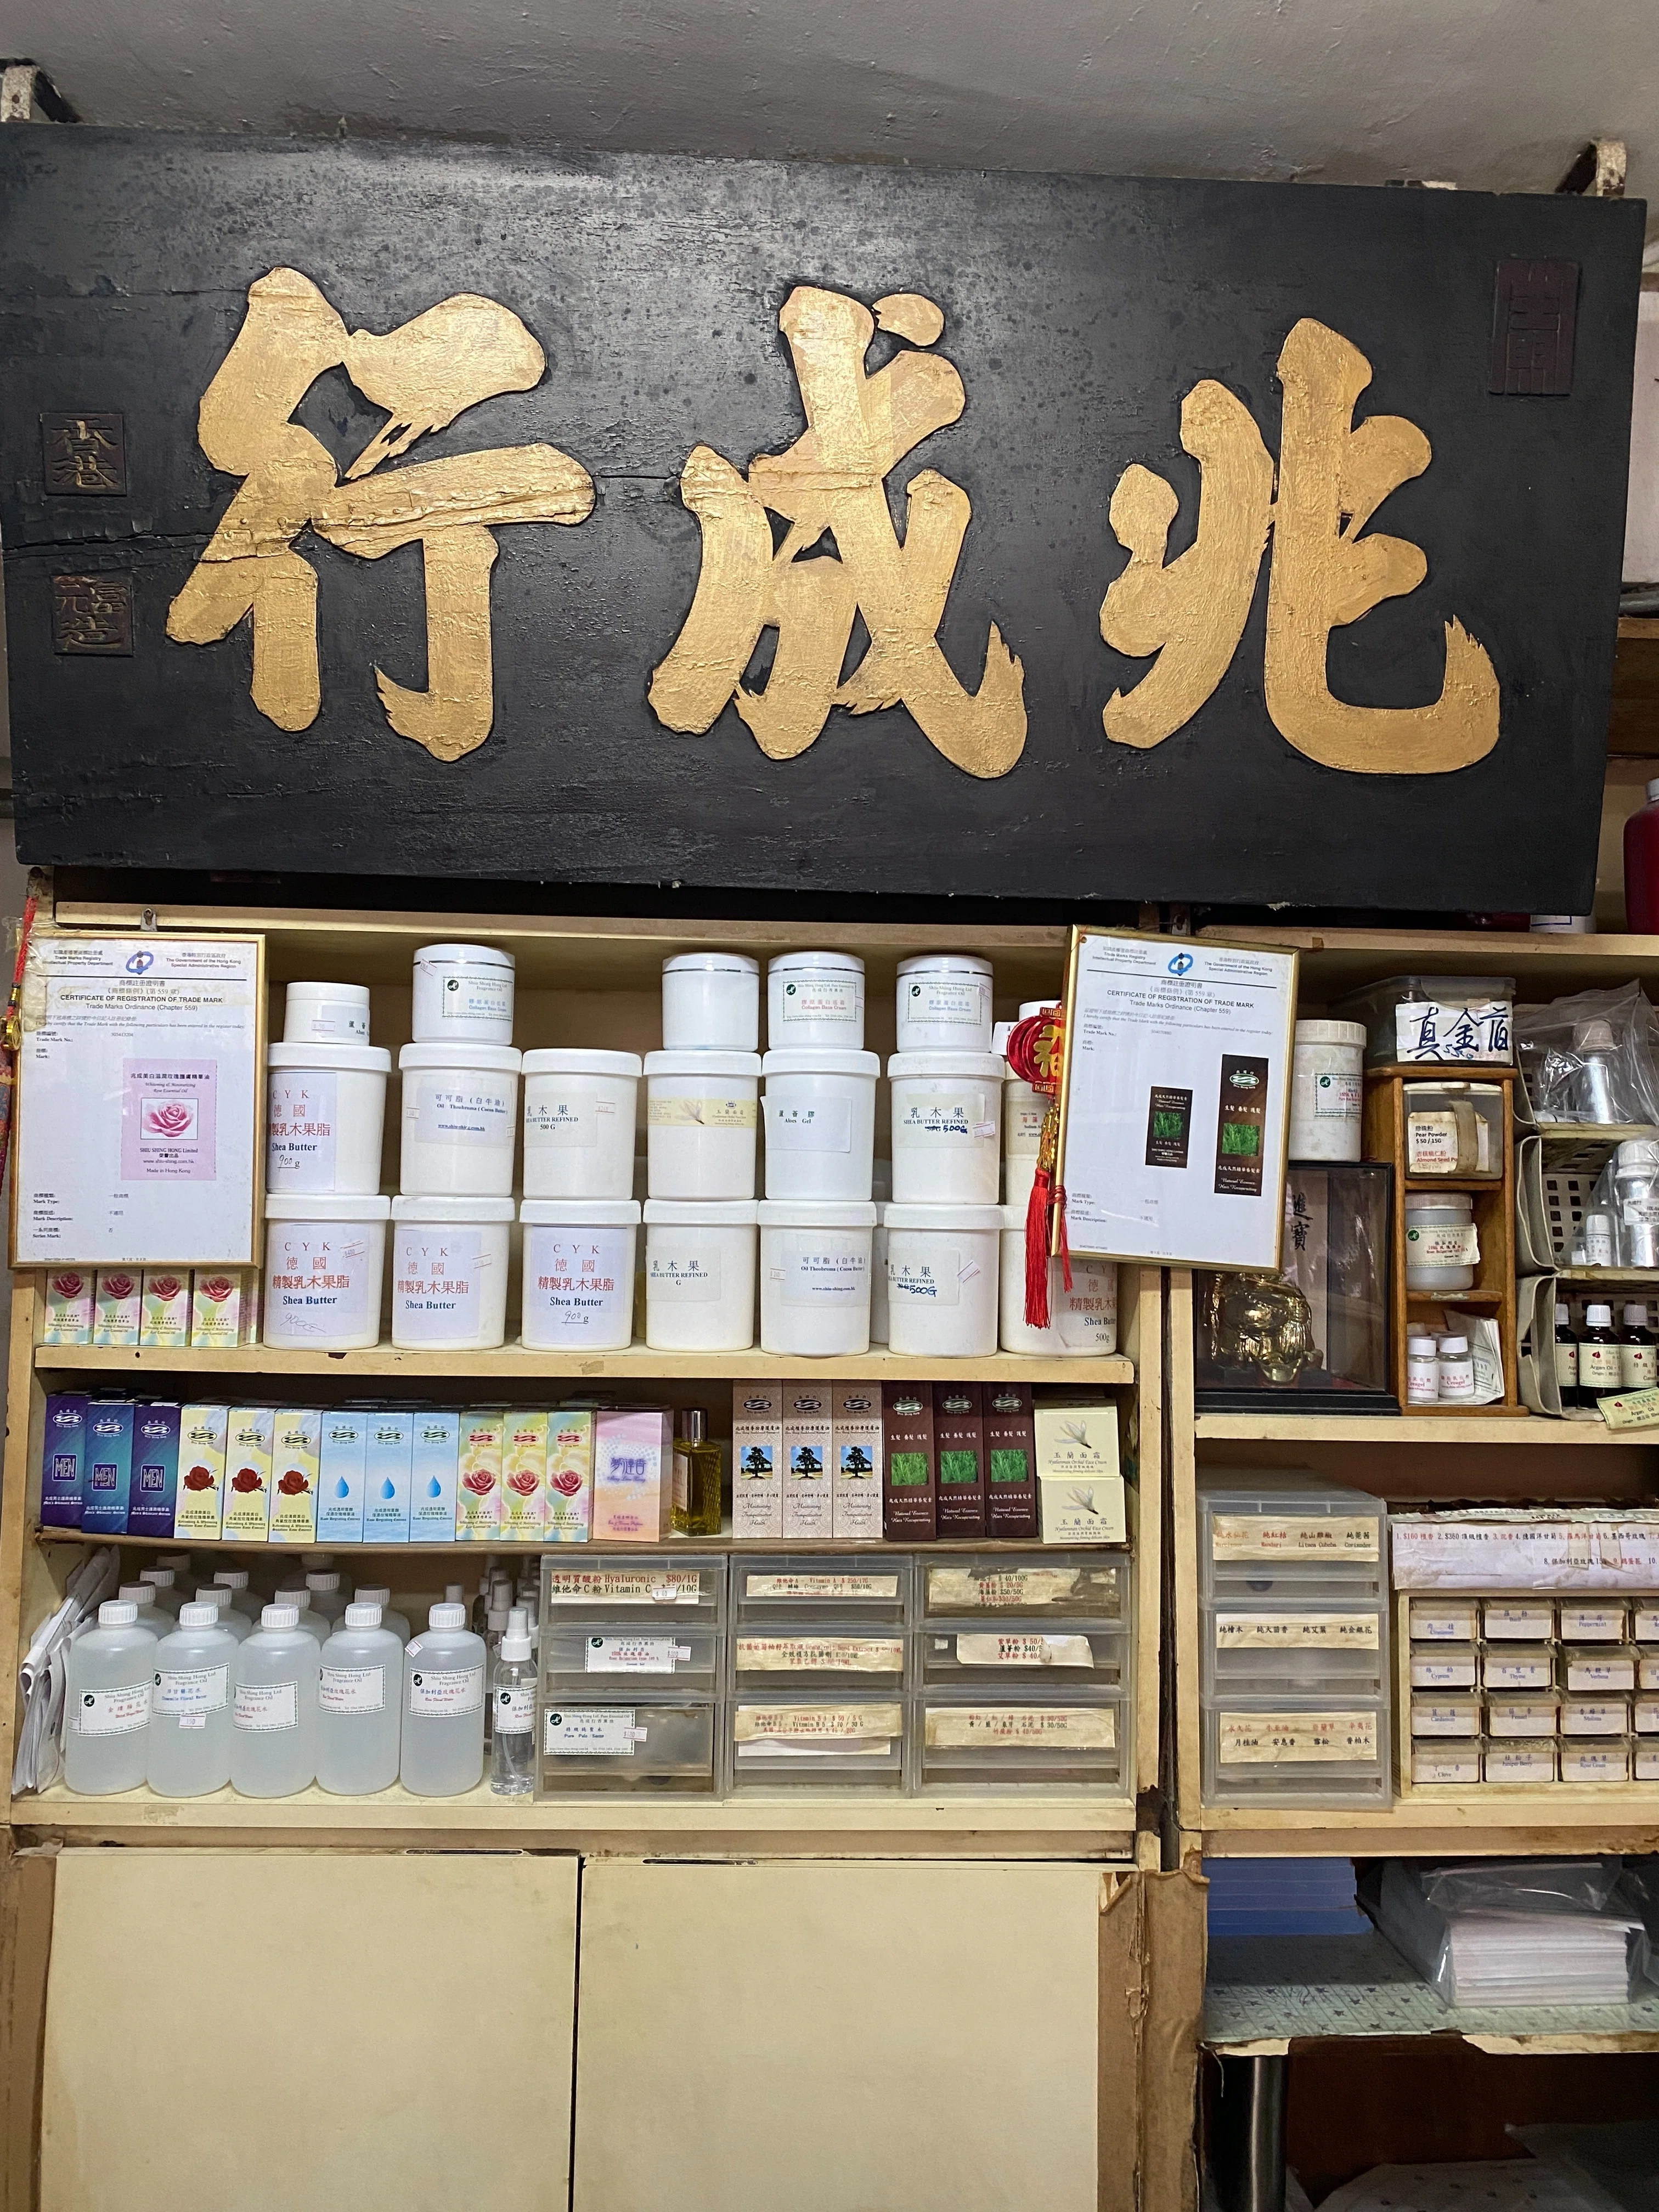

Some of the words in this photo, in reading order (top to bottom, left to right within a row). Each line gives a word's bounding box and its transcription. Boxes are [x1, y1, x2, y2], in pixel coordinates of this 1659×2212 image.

[1107, 990, 1146, 998] CERTIFICATE
[1158, 994, 1203, 1003] REGISTRATION
[911, 1107, 964, 1118] 乳木果
[269, 1123, 330, 1137] 製乳木果脂
[272, 1143, 286, 1152] Shea
[289, 1143, 317, 1152] Butter
[286, 1256, 326, 1270] 德國
[408, 1261, 444, 1275] 德國
[555, 1259, 595, 1272] 德國
[273, 1275, 350, 1289] 精製乳木果脂
[398, 1280, 469, 1294] 精製乳木果脂
[538, 1277, 614, 1291] 精製乳木果脂
[283, 1296, 303, 1305] Shea
[306, 1296, 337, 1305] Butter
[406, 1300, 423, 1309] Shea
[426, 1301, 456, 1310] Butter
[550, 1297, 570, 1306] Shea
[574, 1297, 603, 1307] Butter
[1085, 1317, 1102, 1326] Shea
[1096, 1333, 1109, 1342] 500g
[55, 1458, 75, 1477] MEN
[95, 1468, 115, 1487] MEN
[143, 1469, 162, 1488] MEN
[605, 1575, 656, 1584] Hyaluronic
[666, 1575, 697, 1583] $80/1G
[605, 1585, 641, 1593] Vitamin
[645, 1585, 651, 1593] C
